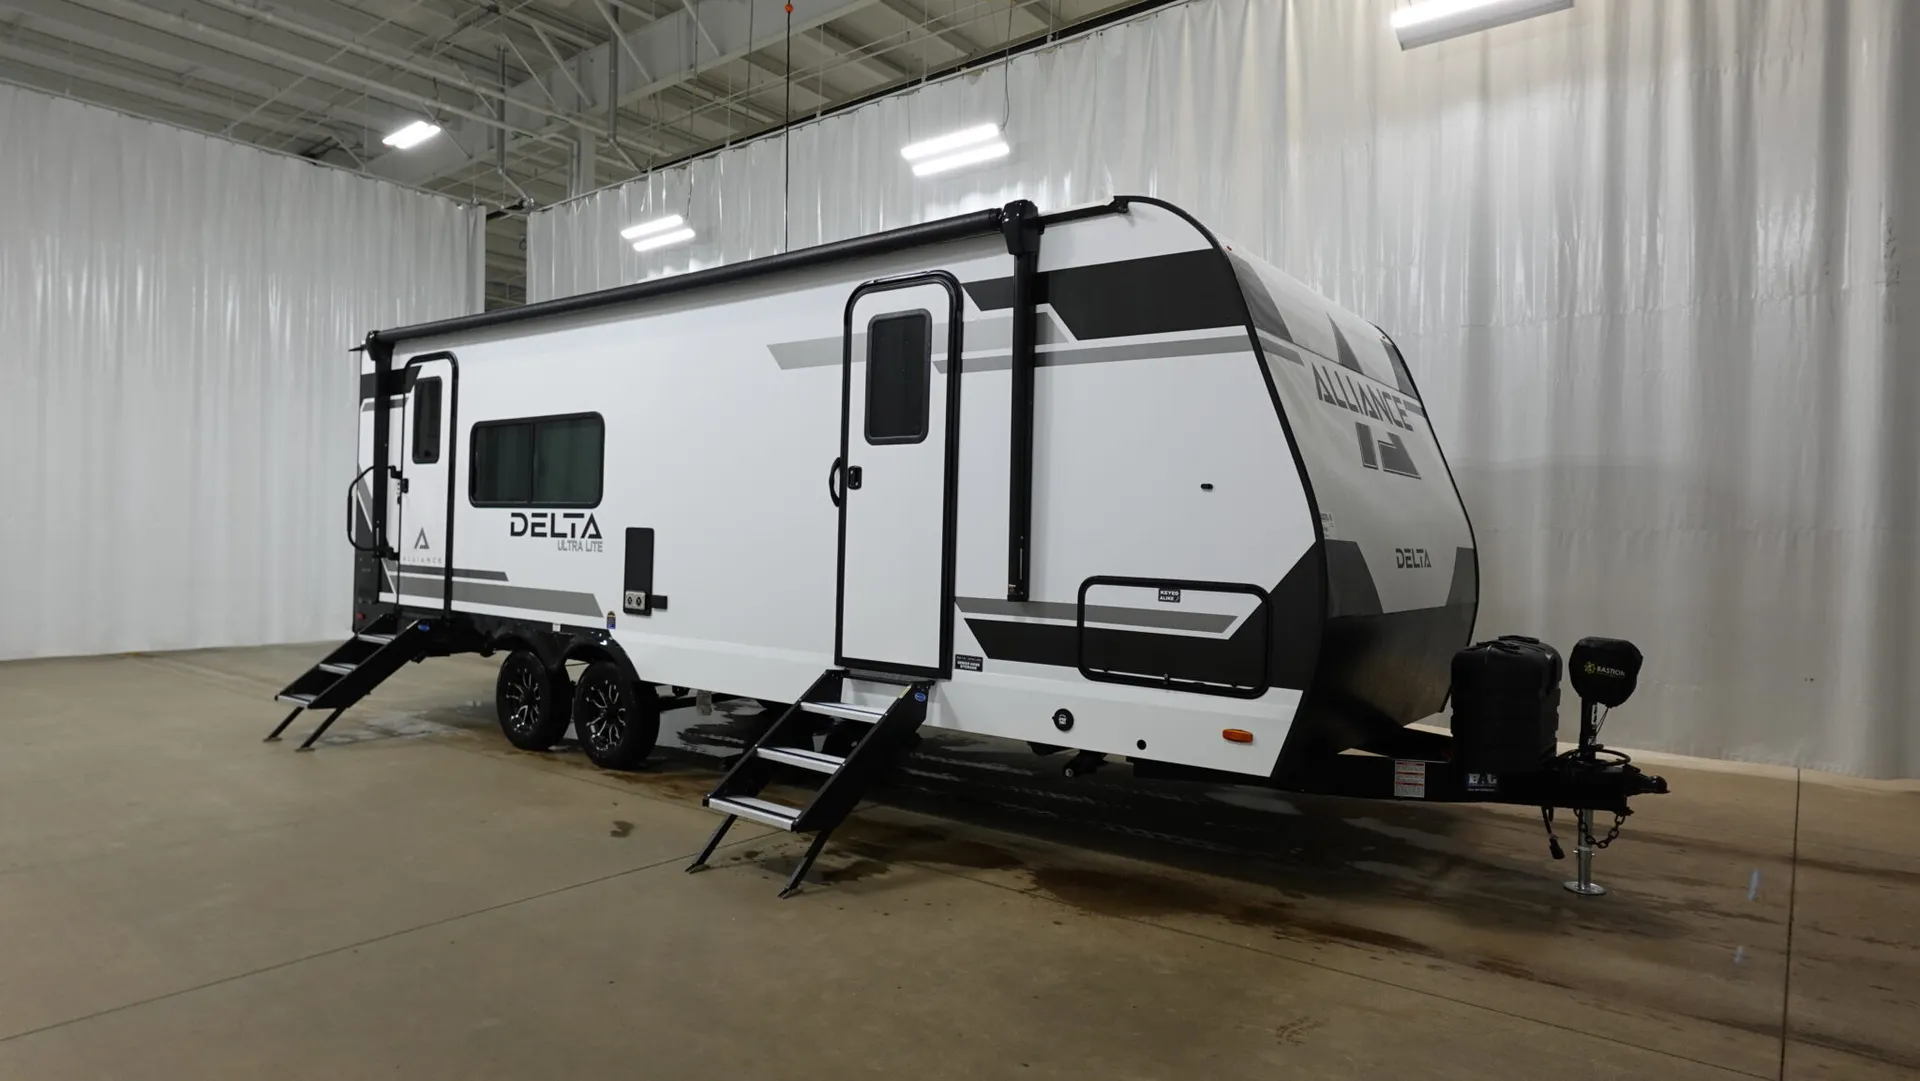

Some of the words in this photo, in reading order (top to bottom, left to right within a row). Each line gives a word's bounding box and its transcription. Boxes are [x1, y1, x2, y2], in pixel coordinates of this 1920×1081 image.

[1311, 362, 1414, 432] ALLIANCE
[510, 512, 603, 539] DELTA
[557, 540, 584, 552] ULTRA
[585, 540, 603, 553] LITE
[402, 556, 442, 564] ALLIANCE
[1395, 548, 1432, 568] DELTA
[1597, 665, 1625, 676] BASTION
